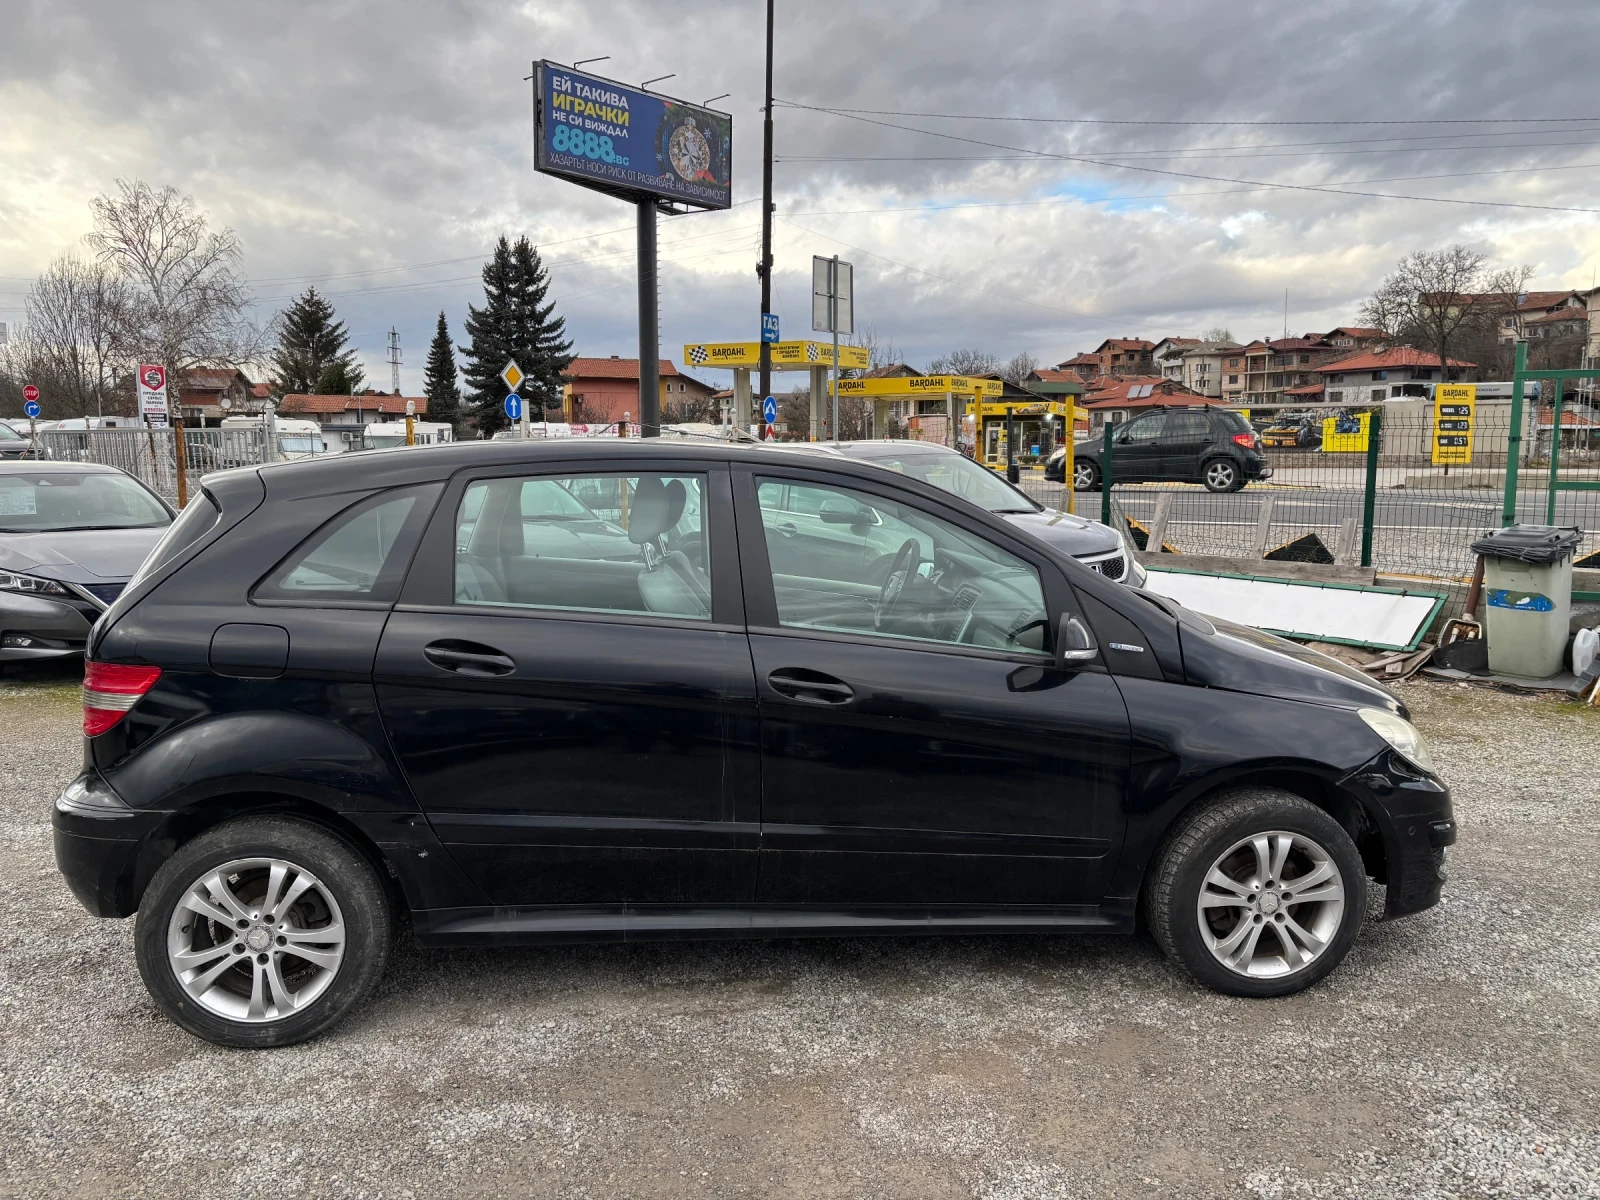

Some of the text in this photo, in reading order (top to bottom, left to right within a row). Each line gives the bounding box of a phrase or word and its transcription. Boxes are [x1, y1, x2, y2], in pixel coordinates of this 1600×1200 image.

[553, 75, 629, 109] ЕЙ ТАКИВА
[552, 91, 629, 126] ИГРАЧКИ
[552, 110, 628, 138] НЕ СИ ВИЖДАЛ
[550, 152, 726, 201] ХАЗАРТЪТ НОСИ РИСК ОТ РАЗВИВАНЕ НА ЗАВИСИМОСТ
[763, 315, 778, 331] ГАЗ
[712, 347, 746, 359] BARDAHL
[837, 381, 866, 392] ARDAHL
[909, 378, 945, 390] BARDAHL
[1443, 389, 1469, 400] BARDAHL
